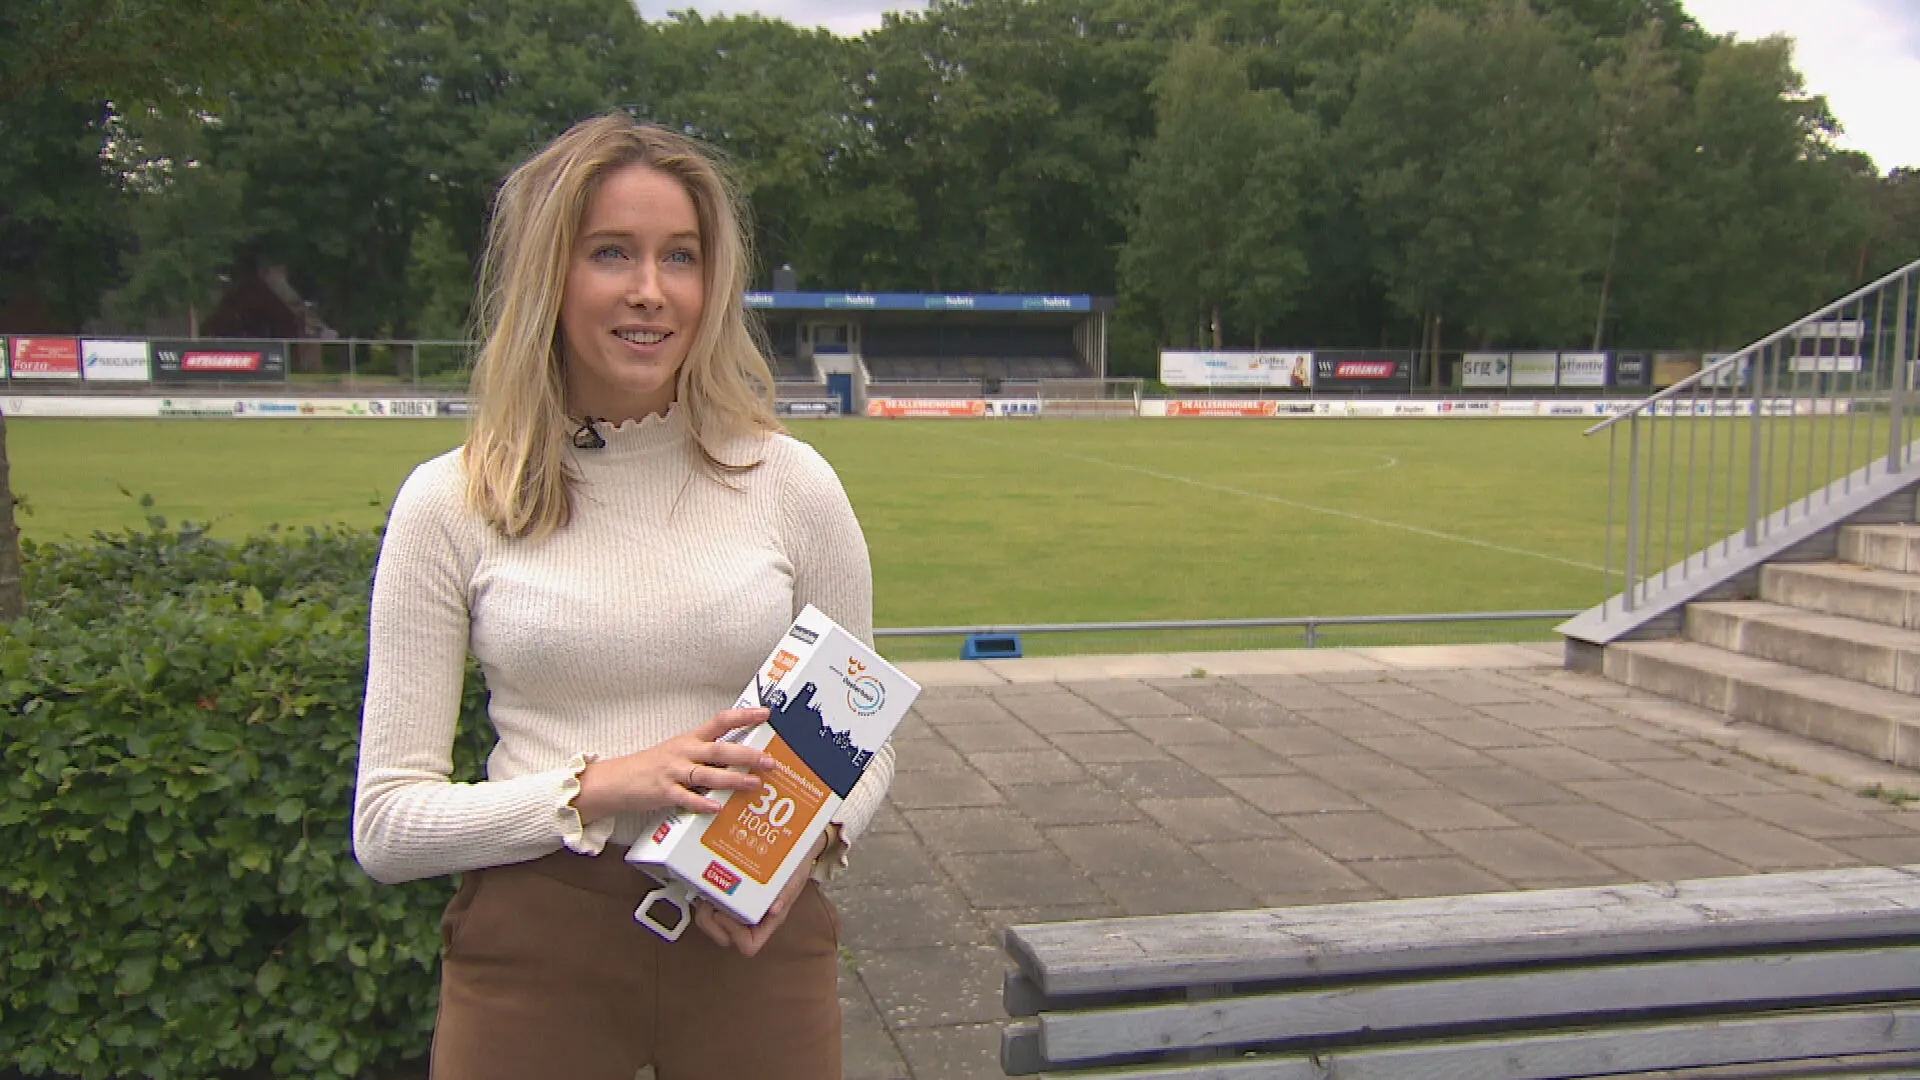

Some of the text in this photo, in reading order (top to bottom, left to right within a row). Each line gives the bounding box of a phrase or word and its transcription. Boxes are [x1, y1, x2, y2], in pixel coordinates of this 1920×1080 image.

[1463, 360, 1490, 376] srg
[748, 783, 796, 828] 30
[737, 806, 780, 845] HOOG
